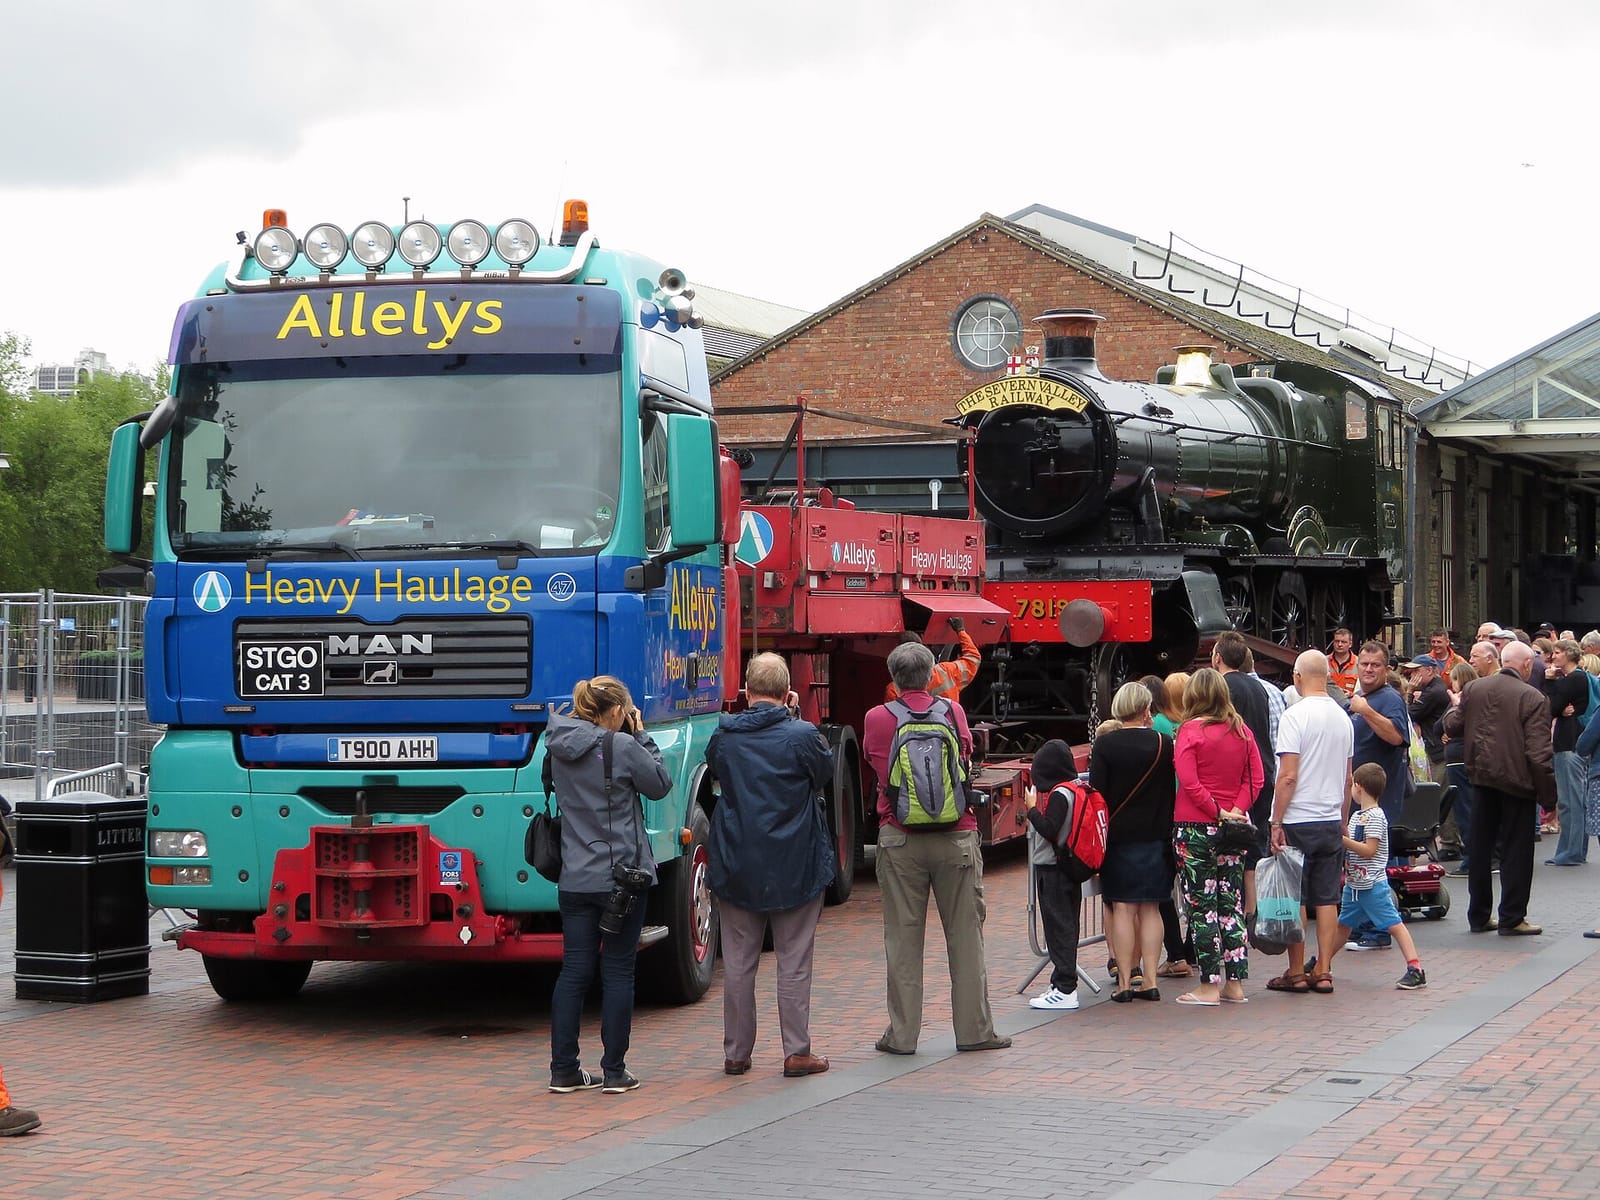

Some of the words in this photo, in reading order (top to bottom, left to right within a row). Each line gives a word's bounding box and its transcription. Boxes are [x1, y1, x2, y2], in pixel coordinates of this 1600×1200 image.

[276, 290, 503, 350] Allelys
[958, 391, 985, 412] THE
[984, 380, 1037, 398] SEVERN
[1039, 382, 1087, 409] VALLEY
[989, 392, 1054, 408] RAILWAY
[843, 542, 875, 572] Allelys
[911, 546, 938, 575] Heavy
[940, 548, 972, 575] Haulage
[245, 570, 360, 614] Heavy
[375, 567, 532, 613] Haulage
[550, 580, 572, 596] 47
[670, 567, 716, 650] Allelys
[246, 646, 318, 669] STGO
[328, 634, 433, 655] MAN
[255, 674, 294, 691] CAT
[298, 674, 310, 691] 3
[664, 650, 688, 689] Heavy
[341, 740, 391, 759] T900
[397, 739, 434, 758] AHH
[98, 828, 142, 845] LITTER
